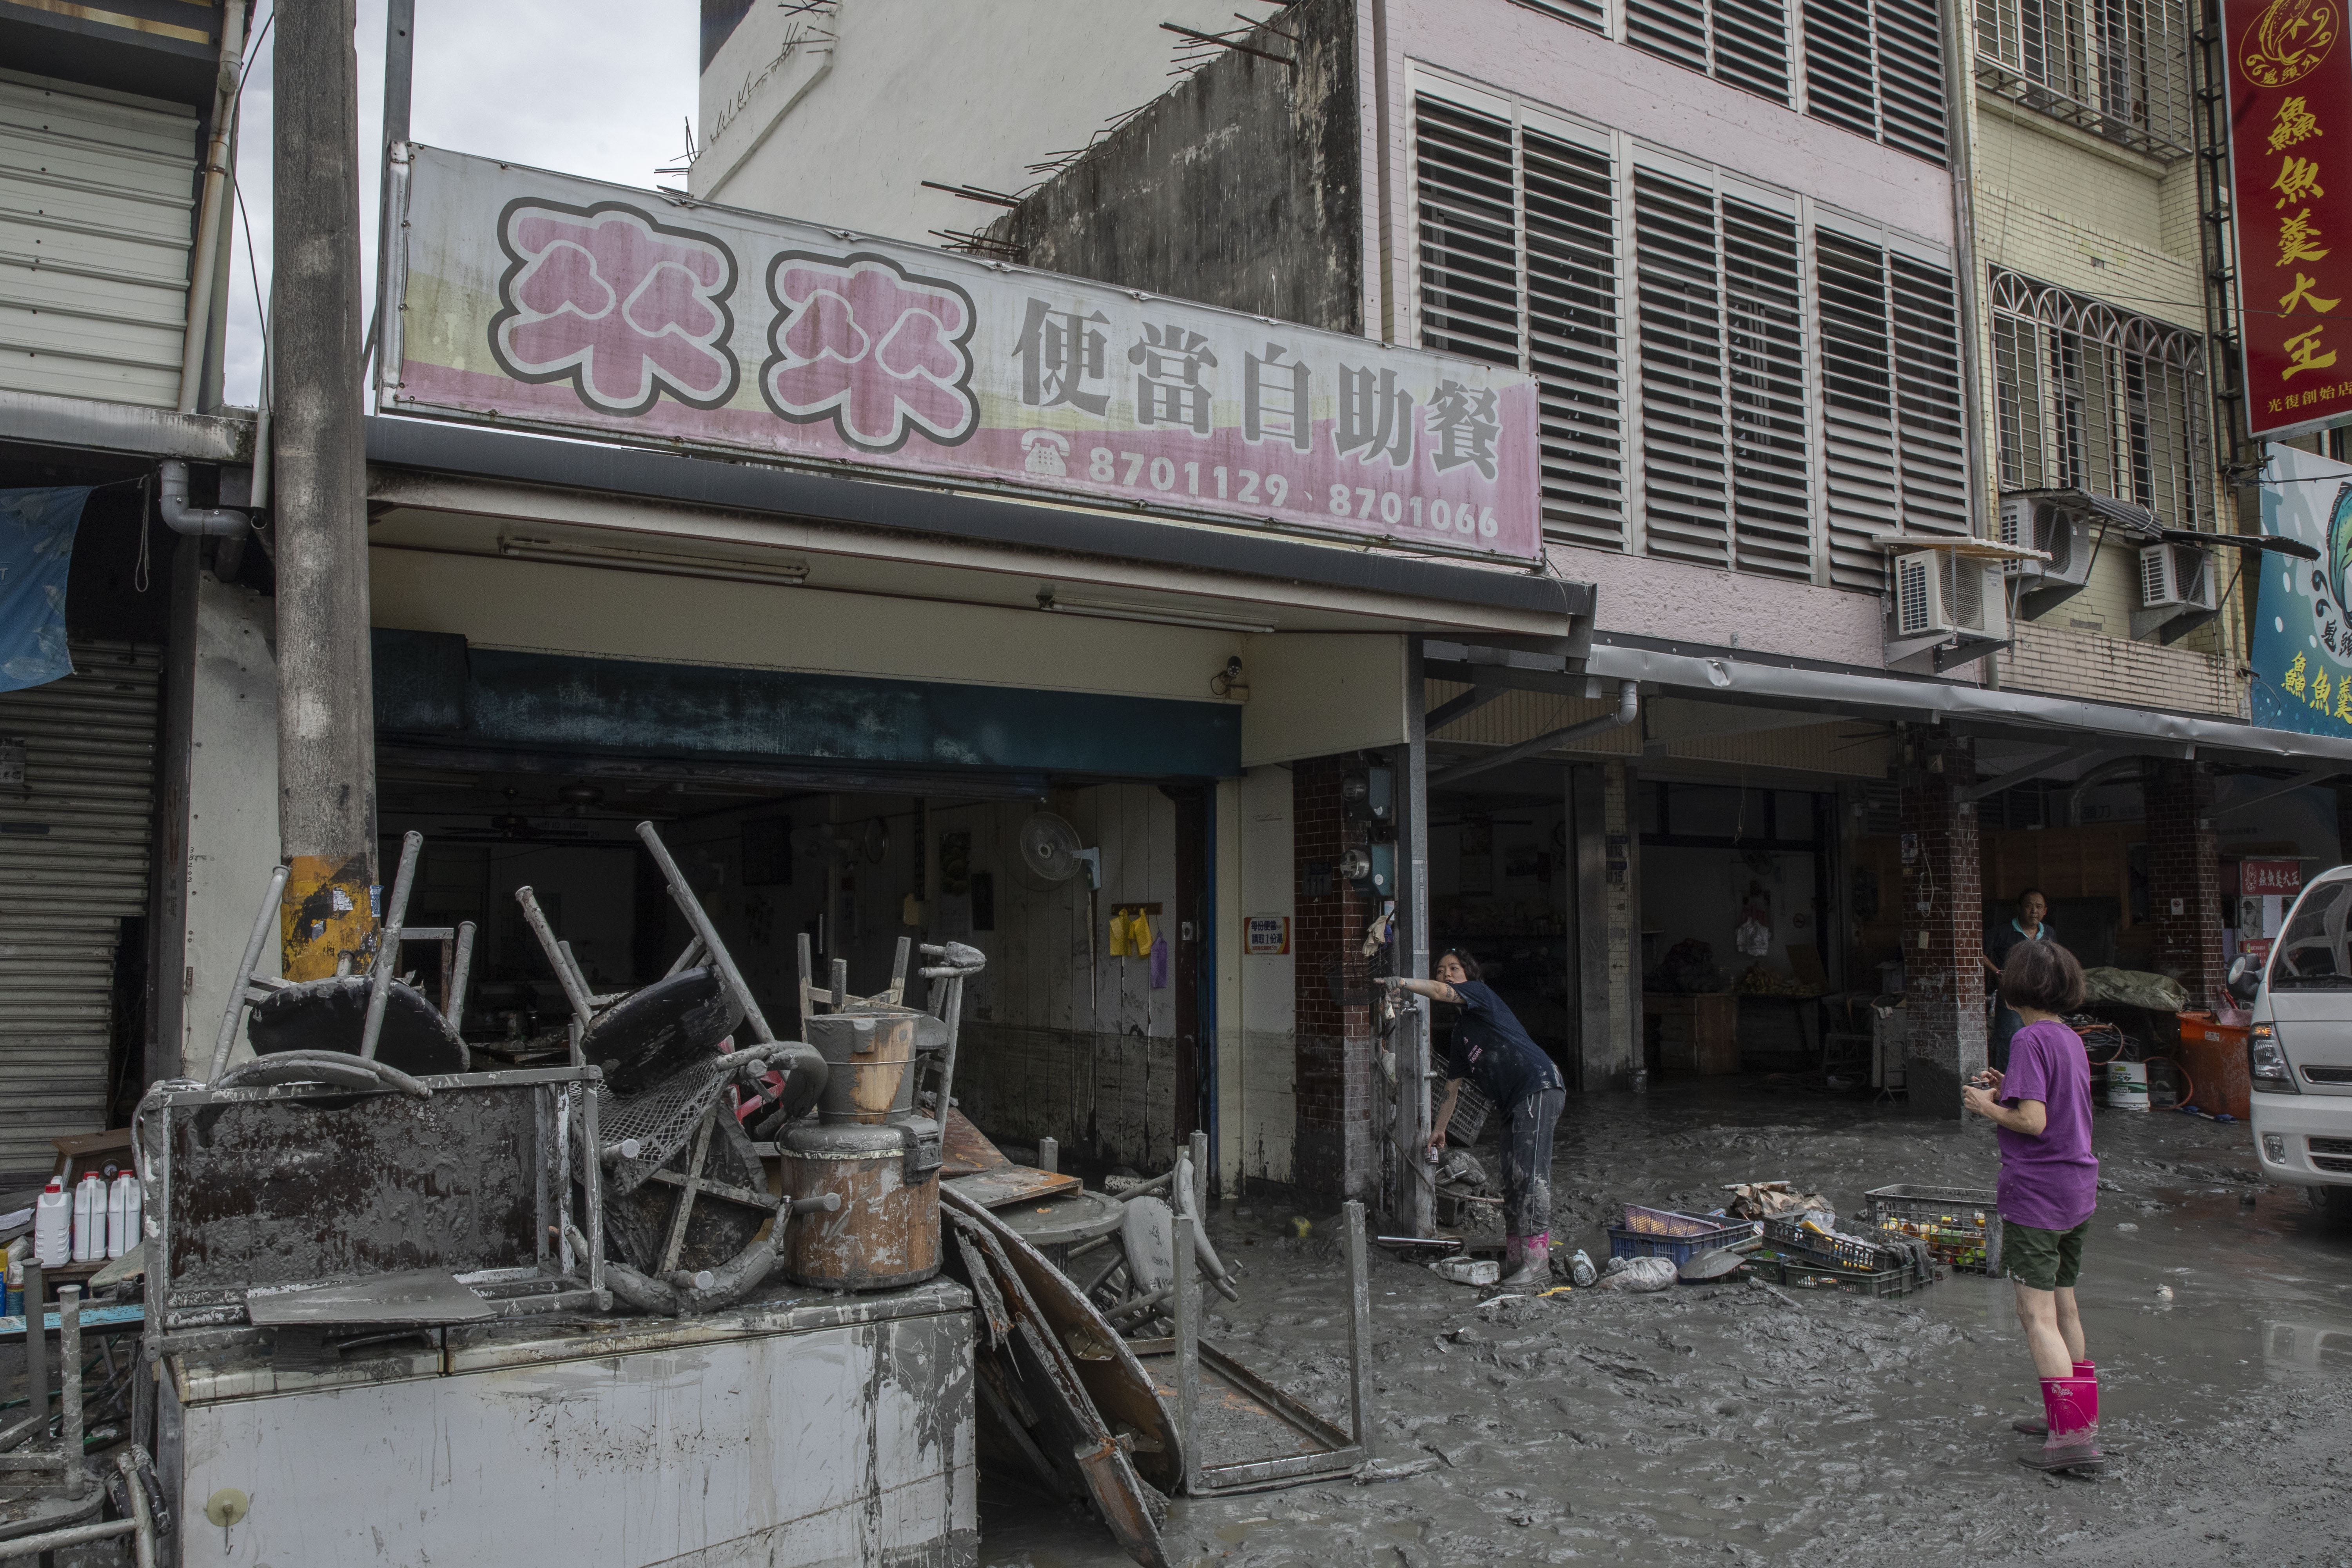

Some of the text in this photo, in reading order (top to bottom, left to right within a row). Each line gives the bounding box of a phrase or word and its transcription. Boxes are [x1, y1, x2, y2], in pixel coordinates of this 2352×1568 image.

[1011, 296, 1504, 482] 便當自助餐
[2267, 382, 2352, 414] 光復創始店
[1328, 482, 1499, 538] 8701066
[2081, 805, 2111, 819] 頭刀
[1251, 920, 1277, 931] 每份便當
[1252, 933, 1283, 944] 請取1份湯
